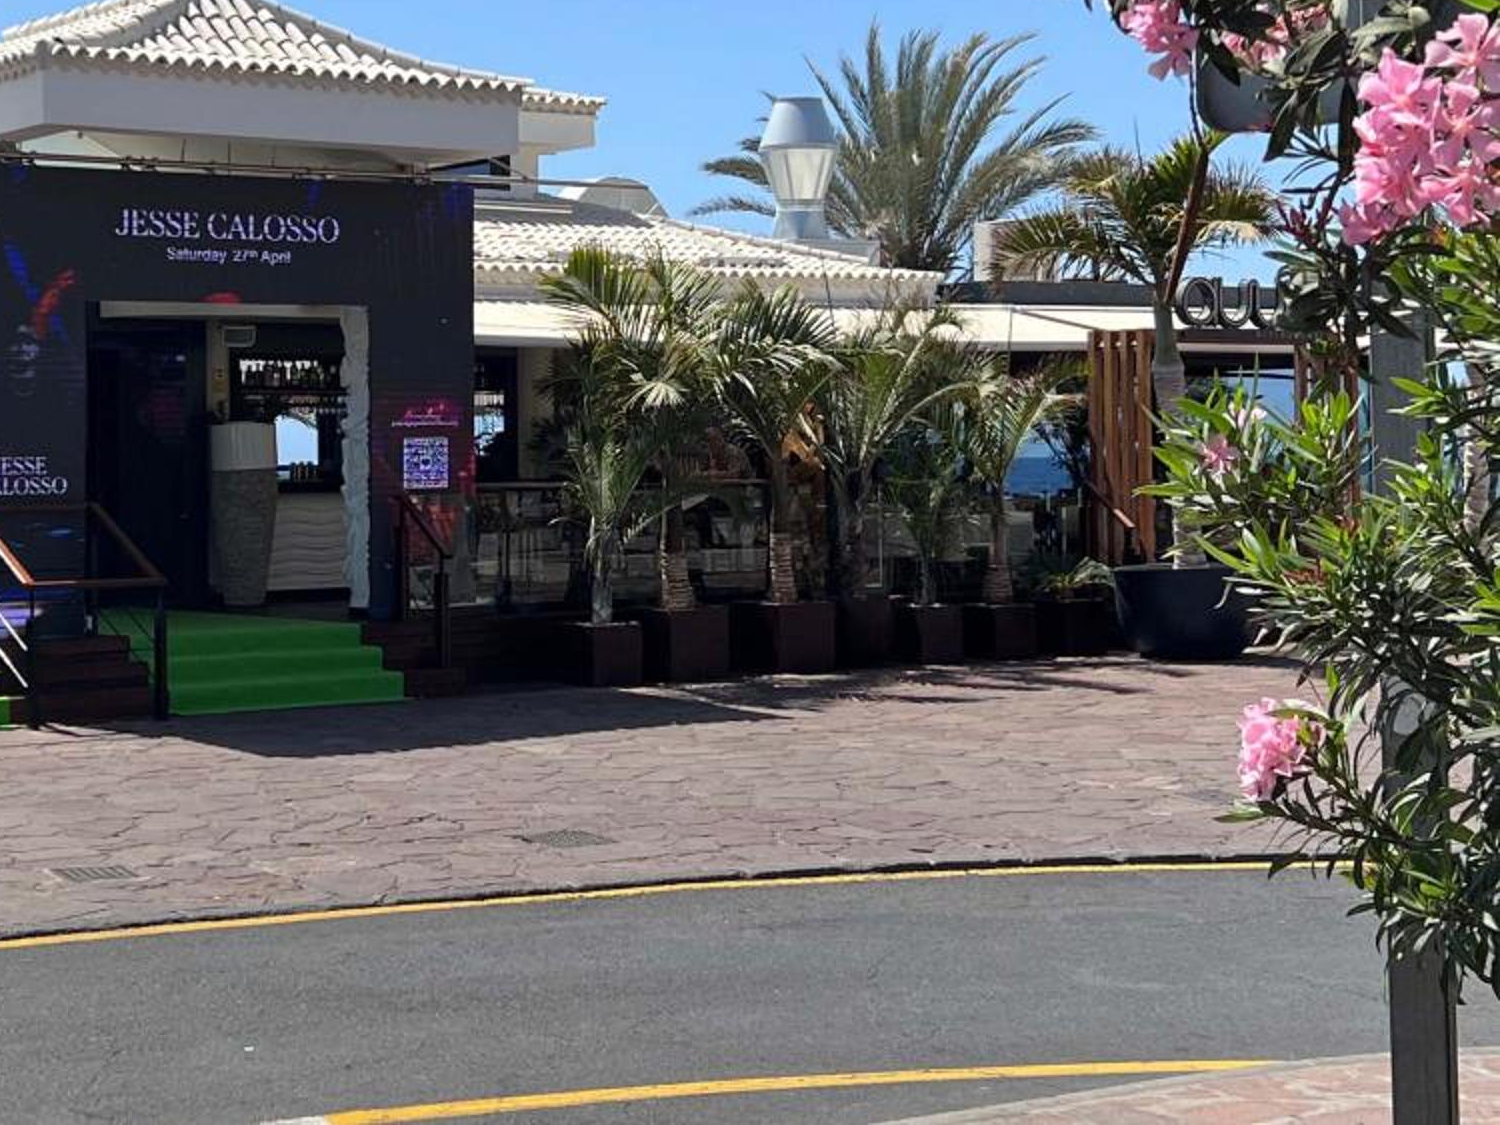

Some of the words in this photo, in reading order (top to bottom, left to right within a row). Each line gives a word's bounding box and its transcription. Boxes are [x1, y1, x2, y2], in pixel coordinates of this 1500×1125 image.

[115, 208, 200, 238] JESSE
[206, 212, 341, 244] CALOSSO
[166, 246, 228, 265] Saturday
[260, 250, 292, 266] April
